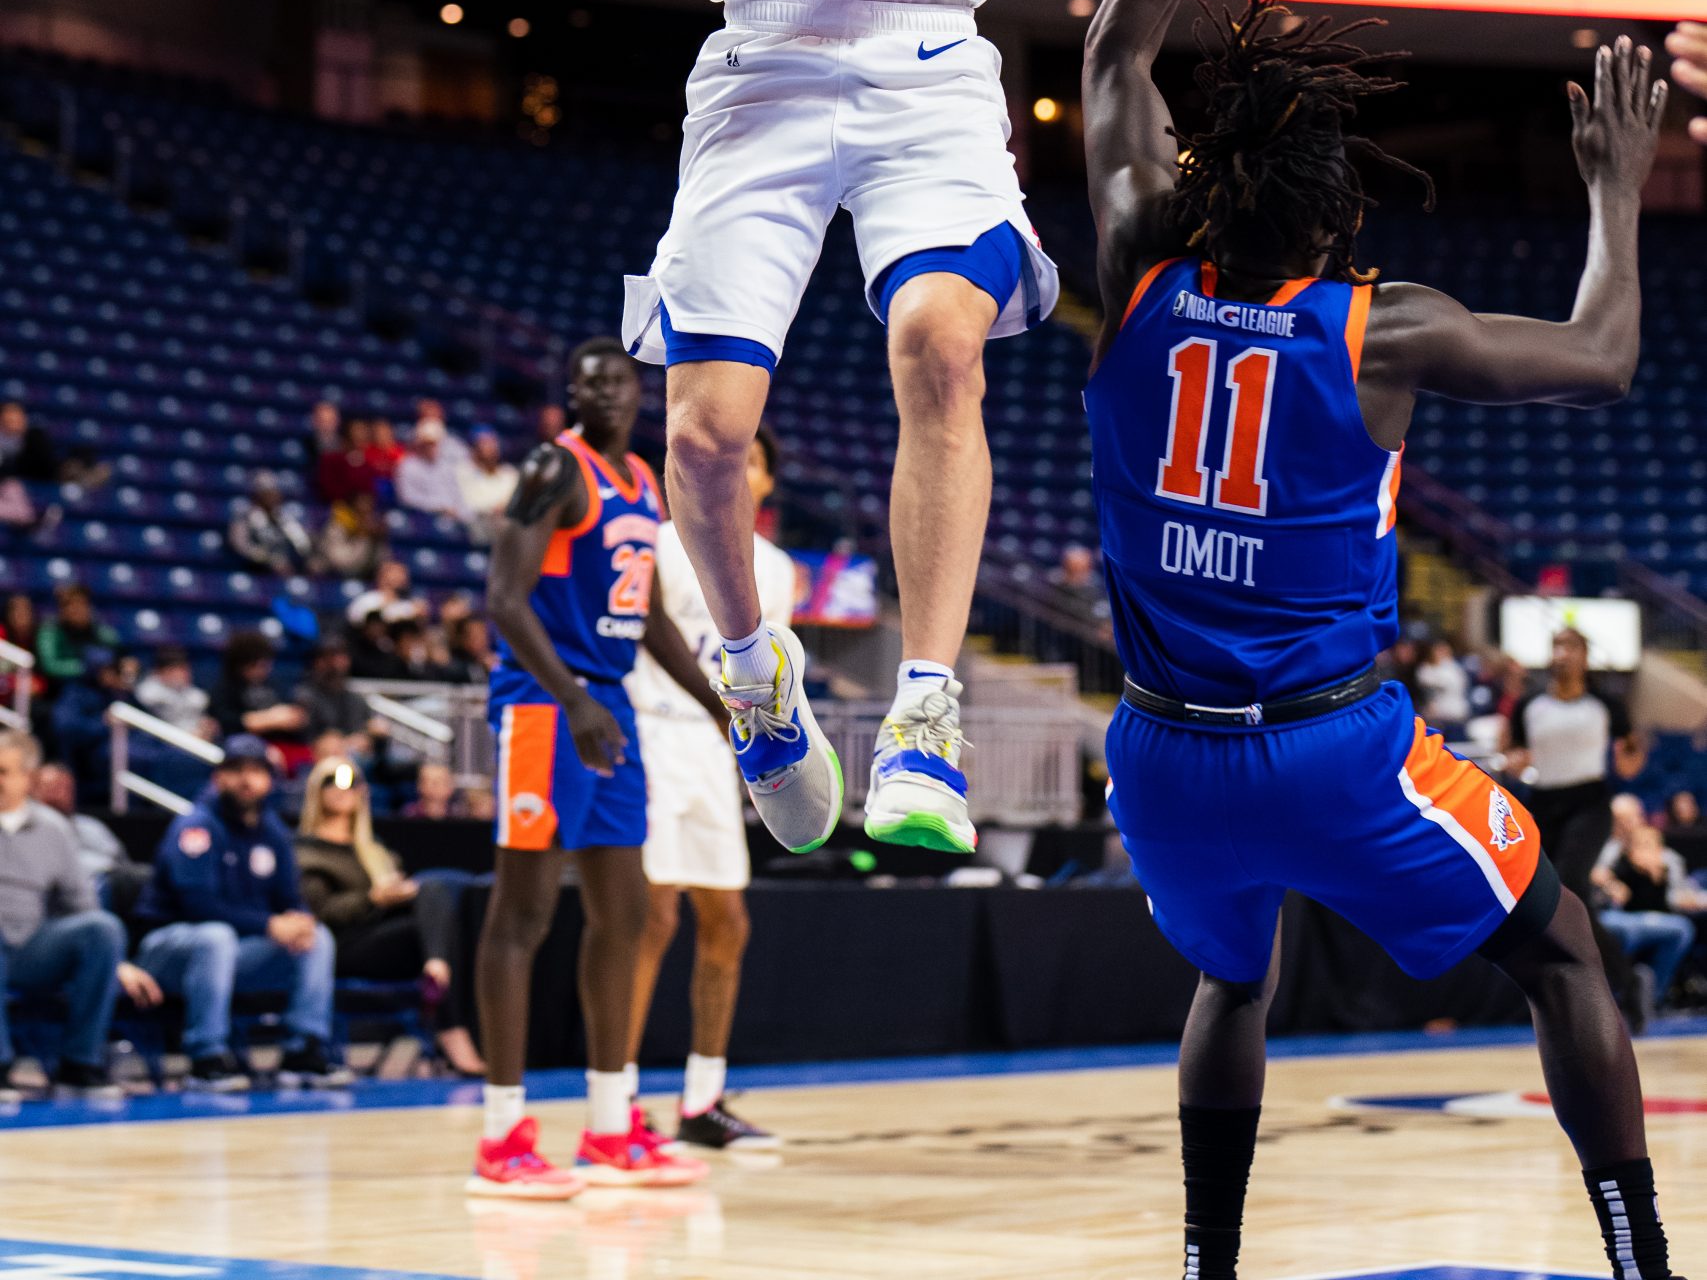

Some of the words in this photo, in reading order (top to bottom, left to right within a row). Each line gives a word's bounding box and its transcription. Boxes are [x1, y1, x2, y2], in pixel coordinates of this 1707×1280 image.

[1185, 293, 1217, 324] NBA
[1216, 304, 1242, 328] G
[1241, 306, 1297, 338] LEAGUE
[1154, 335, 1279, 518] 11
[1160, 520, 1264, 588] OMOT
